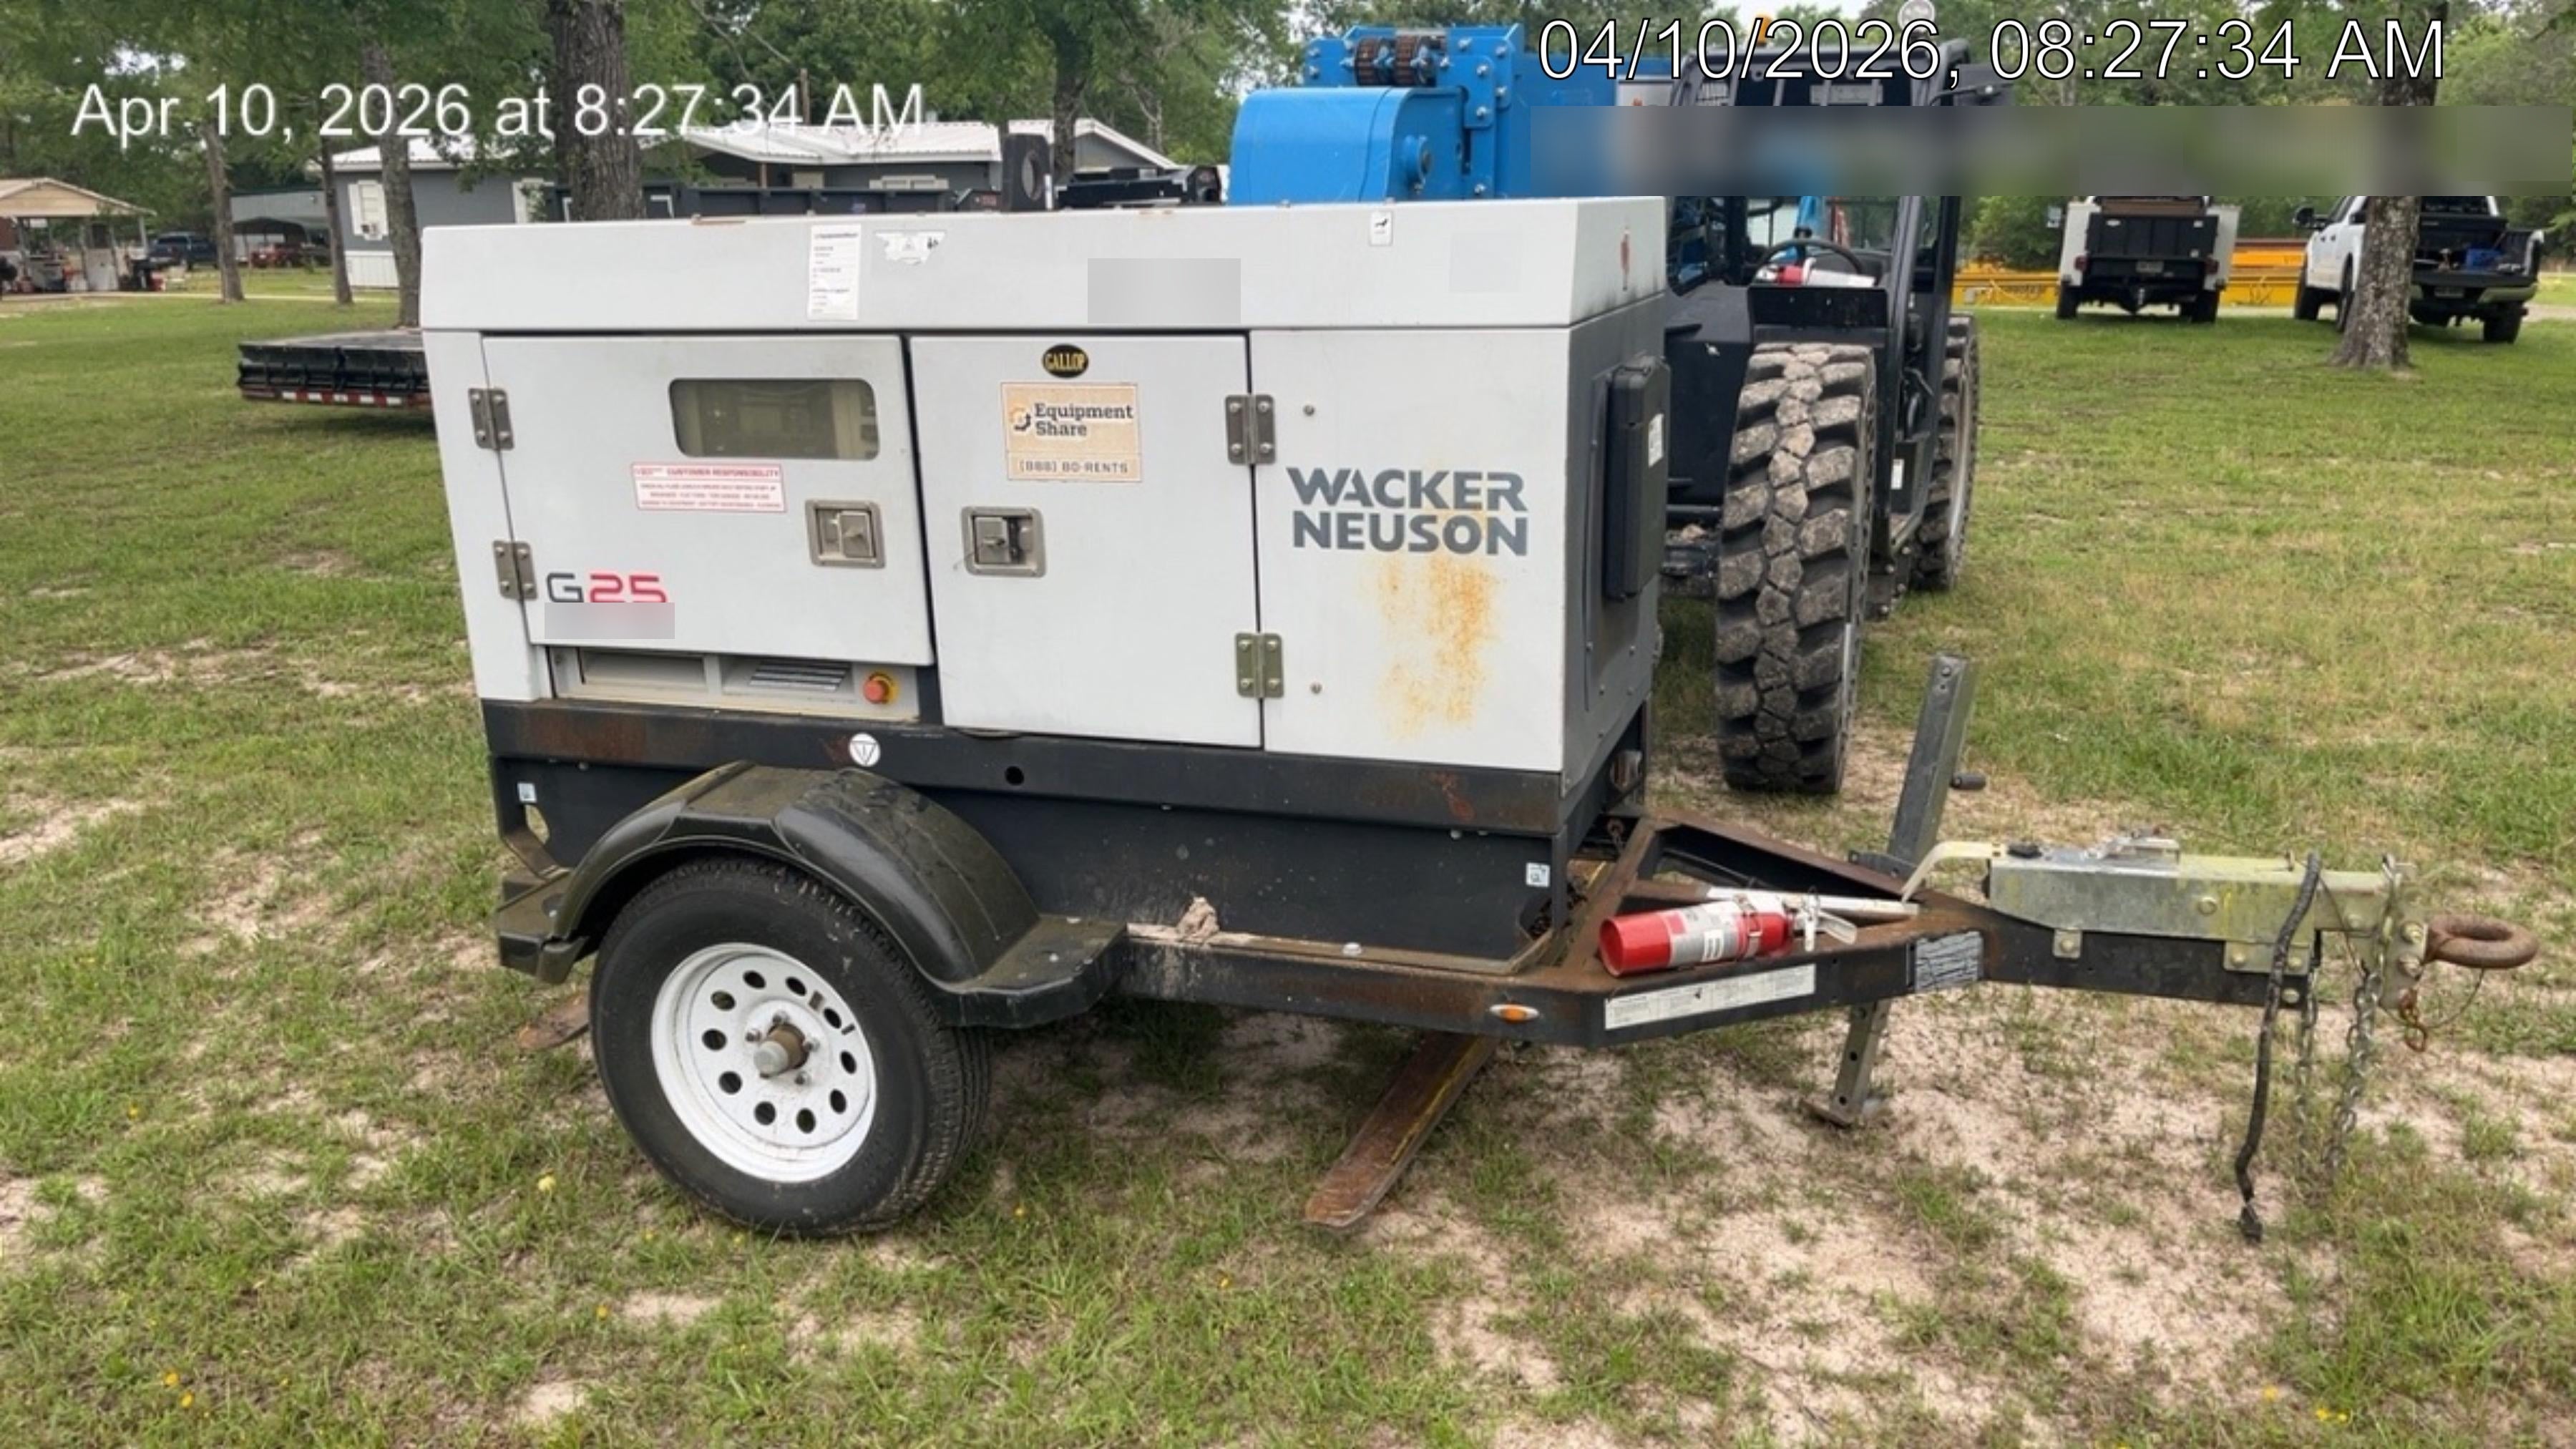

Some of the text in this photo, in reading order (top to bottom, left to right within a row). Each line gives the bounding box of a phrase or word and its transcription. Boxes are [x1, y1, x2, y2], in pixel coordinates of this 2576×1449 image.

[1035, 403, 1133, 421] Equipment
[1035, 421, 1087, 436] Share
[1286, 467, 1528, 512] WACKER
[1293, 510, 1528, 556] NEUSON
[547, 572, 668, 602] G25
